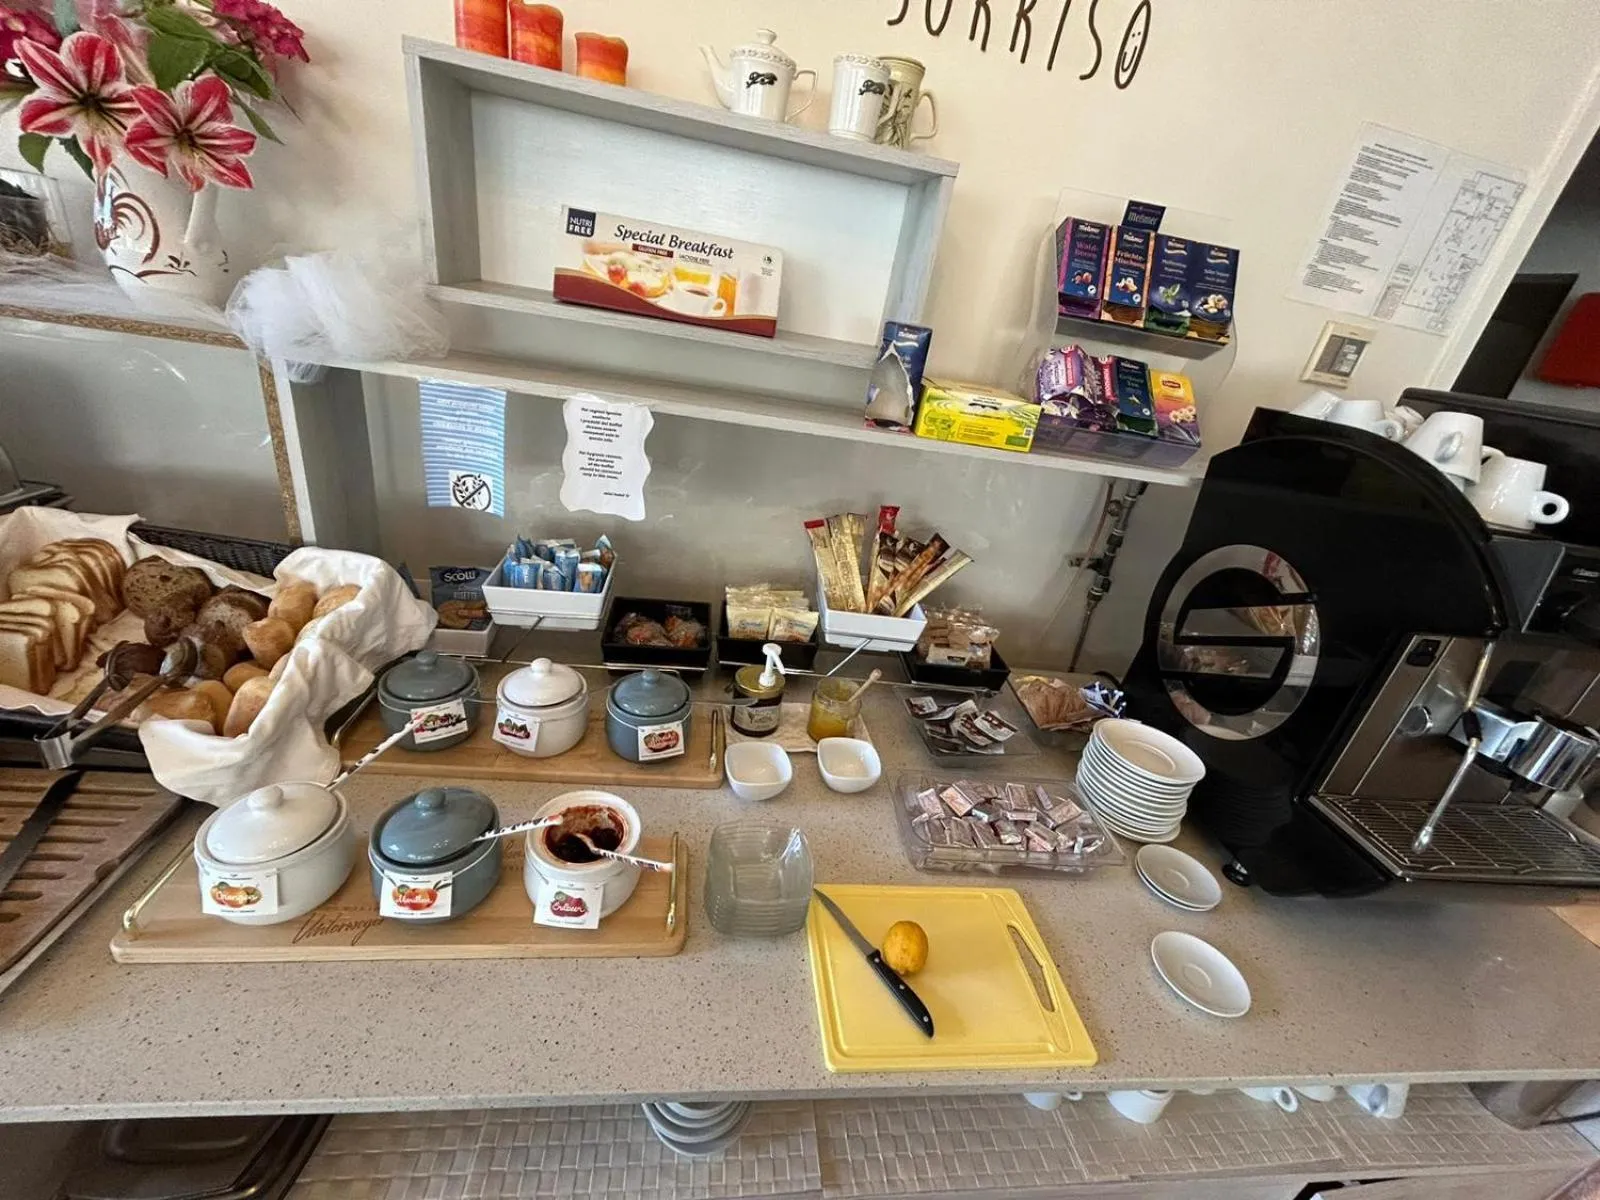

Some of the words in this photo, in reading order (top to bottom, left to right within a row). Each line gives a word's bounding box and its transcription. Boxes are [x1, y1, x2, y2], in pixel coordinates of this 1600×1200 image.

[569, 216, 593, 227] NUTRI
[569, 224, 592, 236] FREE
[614, 224, 666, 246] Special
[669, 235, 734, 259] Breakfast
